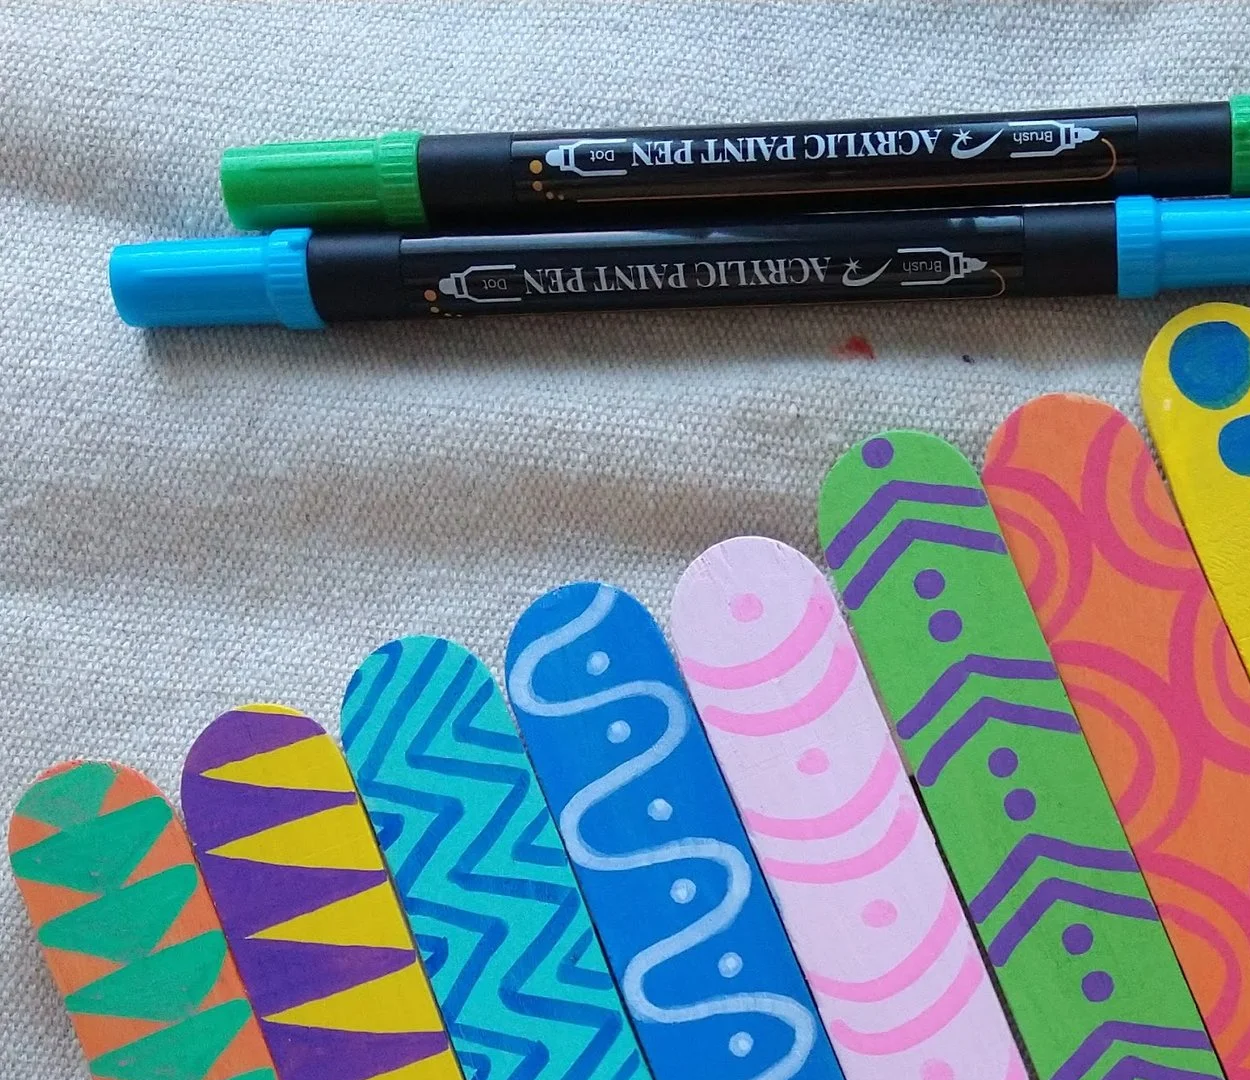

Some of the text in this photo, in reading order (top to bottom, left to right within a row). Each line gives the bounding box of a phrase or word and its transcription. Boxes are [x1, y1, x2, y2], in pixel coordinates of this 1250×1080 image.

[1012, 129, 1053, 147] Brush
[589, 148, 616, 163] Dot
[630, 127, 943, 167] ACRYLIC PAINT PEN
[523, 256, 832, 295] ACRYLIC PAINT PEN
[902, 259, 943, 276] Brush
[481, 277, 508, 292] Dot
